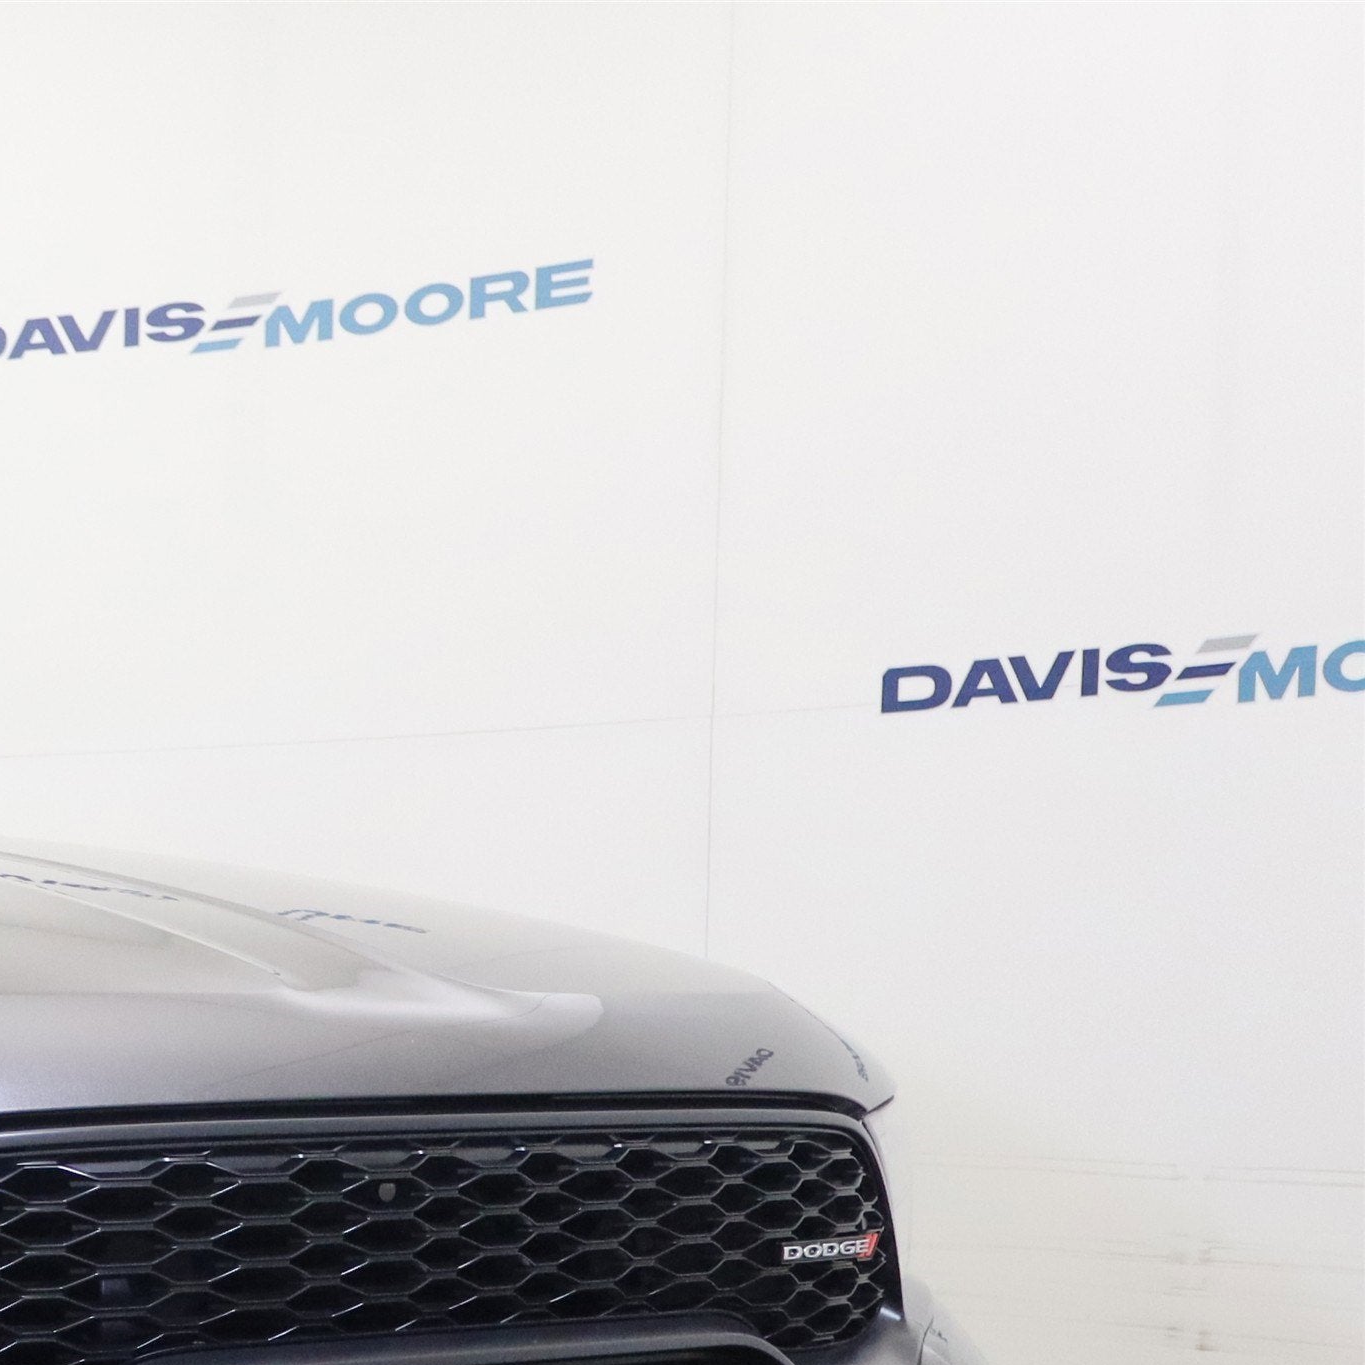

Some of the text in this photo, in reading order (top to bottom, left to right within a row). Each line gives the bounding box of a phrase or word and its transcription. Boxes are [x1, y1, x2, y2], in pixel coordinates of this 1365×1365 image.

[263, 258, 594, 349] MOORE
[881, 642, 1173, 714] DAVIS
[783, 1239, 871, 1261] DODGE
